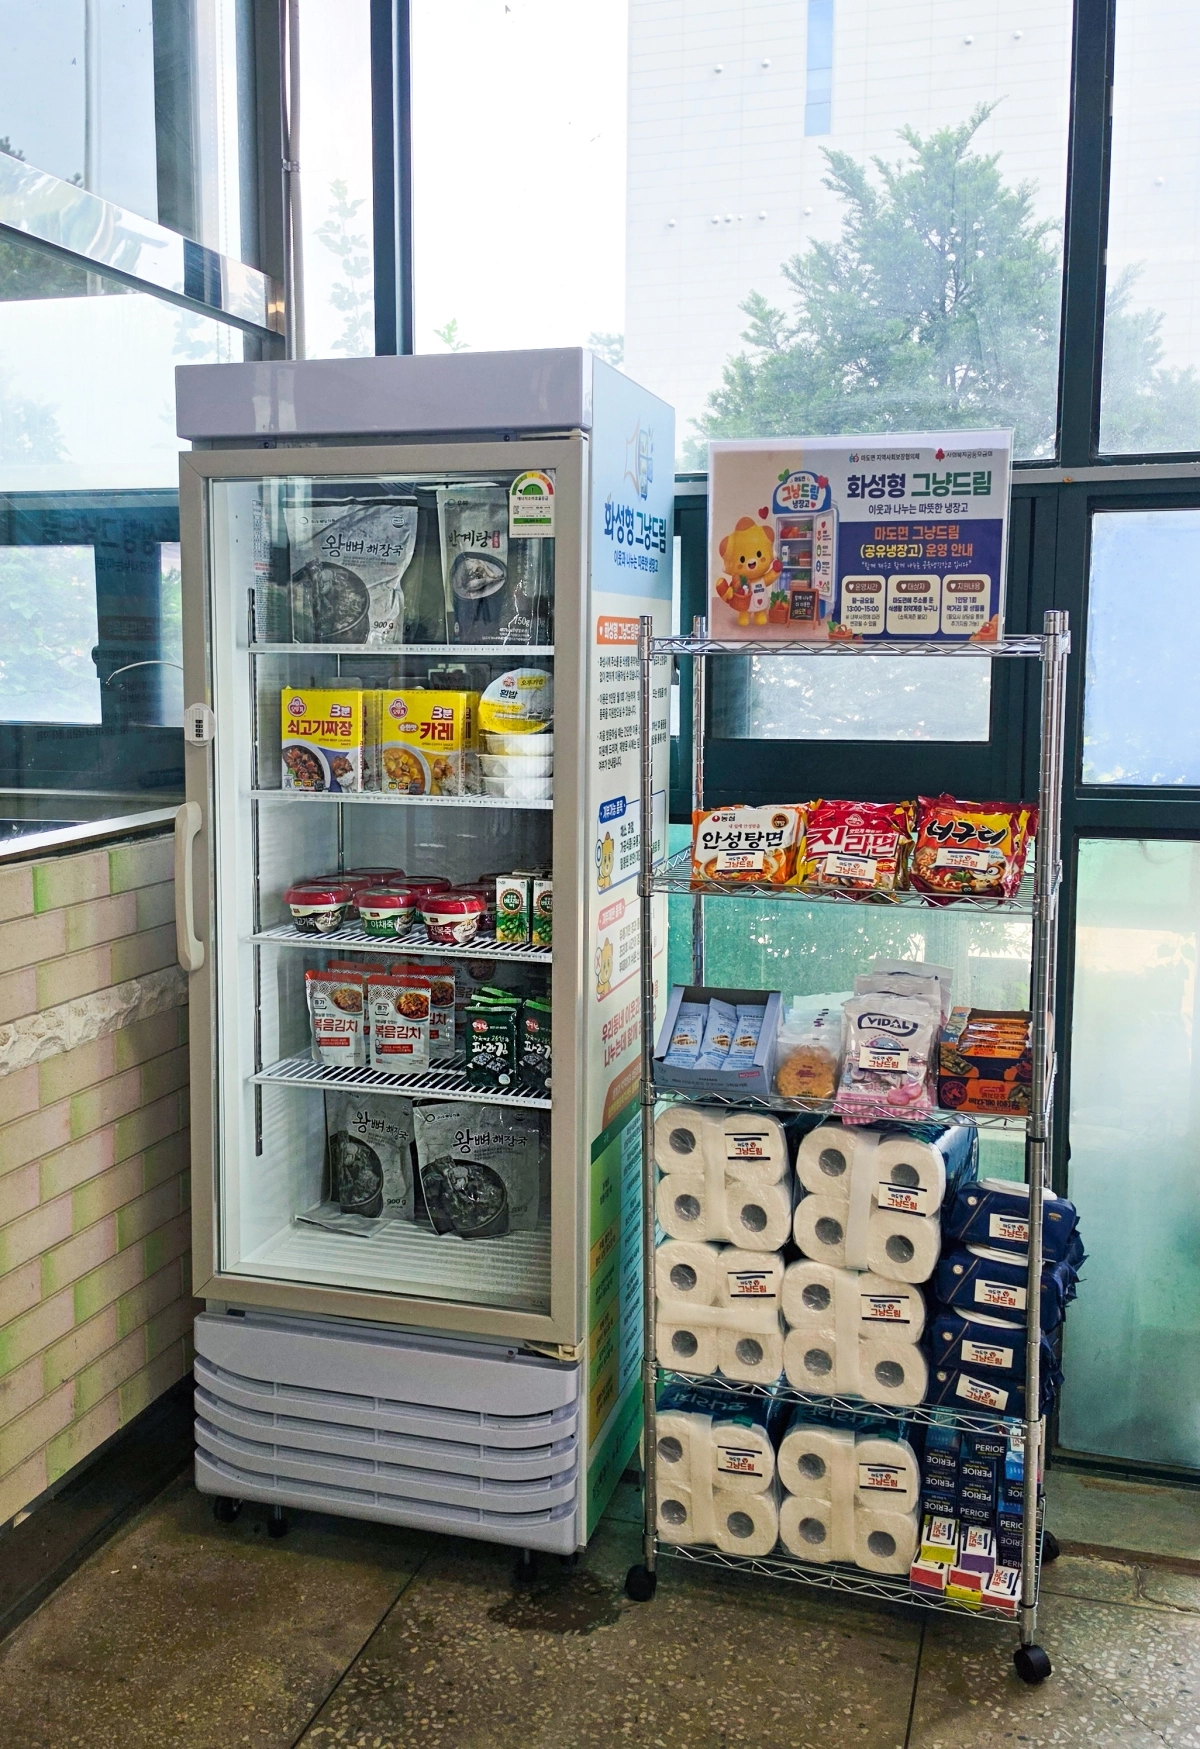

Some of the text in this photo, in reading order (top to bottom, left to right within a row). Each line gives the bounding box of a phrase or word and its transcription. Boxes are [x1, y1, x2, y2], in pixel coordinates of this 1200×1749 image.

[847, 471, 992, 499] 화성형 그냥드림
[782, 483, 820, 502] 그냥드림
[792, 500, 810, 509] 냉장고
[869, 503, 968, 515] 이웃과 나누는 따뜻한 냉장고
[604, 501, 635, 546] 화성형
[636, 511, 666, 553] 그냥드림
[875, 525, 959, 541] 마도면 그냥드림
[321, 533, 404, 558] 왕뼈 해장국
[860, 543, 973, 558] (공유냉장고) 운영 안내
[908, 583, 925, 591] 대상자
[373, 621, 394, 631] 900 g
[500, 689, 518, 699] 흰밥
[330, 704, 352, 718] 3분
[431, 706, 454, 720] 3분
[287, 720, 353, 737] 쇠고기짜장
[420, 722, 454, 740] 카레
[721, 814, 736, 822] 농심
[926, 819, 1006, 845] 너구리
[702, 830, 784, 849] 안성탕면
[946, 859, 978, 868] 그냥드림
[835, 866, 866, 876] 그냥드림
[371, 920, 394, 929] 야채죽
[314, 1018, 358, 1033] 볶음김치
[602, 1011, 625, 1042] 우리동네
[868, 1017, 910, 1030] VIDAL
[375, 1025, 421, 1039] 볶음김치
[868, 1060, 899, 1069] 그냥드림
[352, 1110, 409, 1140] 왕뼈 해장국
[453, 1129, 528, 1154] 왕뼈 해장국
[735, 1147, 763, 1155] 그냥드림
[887, 1197, 917, 1210] 그냥드림
[738, 1285, 767, 1293] 그냥드림
[984, 1293, 1016, 1306] 그냥드림
[871, 1308, 901, 1318] 그냥드림
[971, 1353, 1003, 1365] 그냥드림
[966, 1390, 996, 1406] 그냥드림
[975, 1444, 1005, 1453] PERIOE
[726, 1461, 754, 1471] 그냥드림
[927, 1456, 956, 1467] PERIOE
[962, 1467, 992, 1478] PERIOE
[868, 1477, 898, 1487] 그냥드림
[925, 1477, 955, 1488] PERIOE
[962, 1490, 992, 1501] PERIOE
[924, 1502, 953, 1513] PERIOE
[960, 1508, 989, 1518] PERIOE
